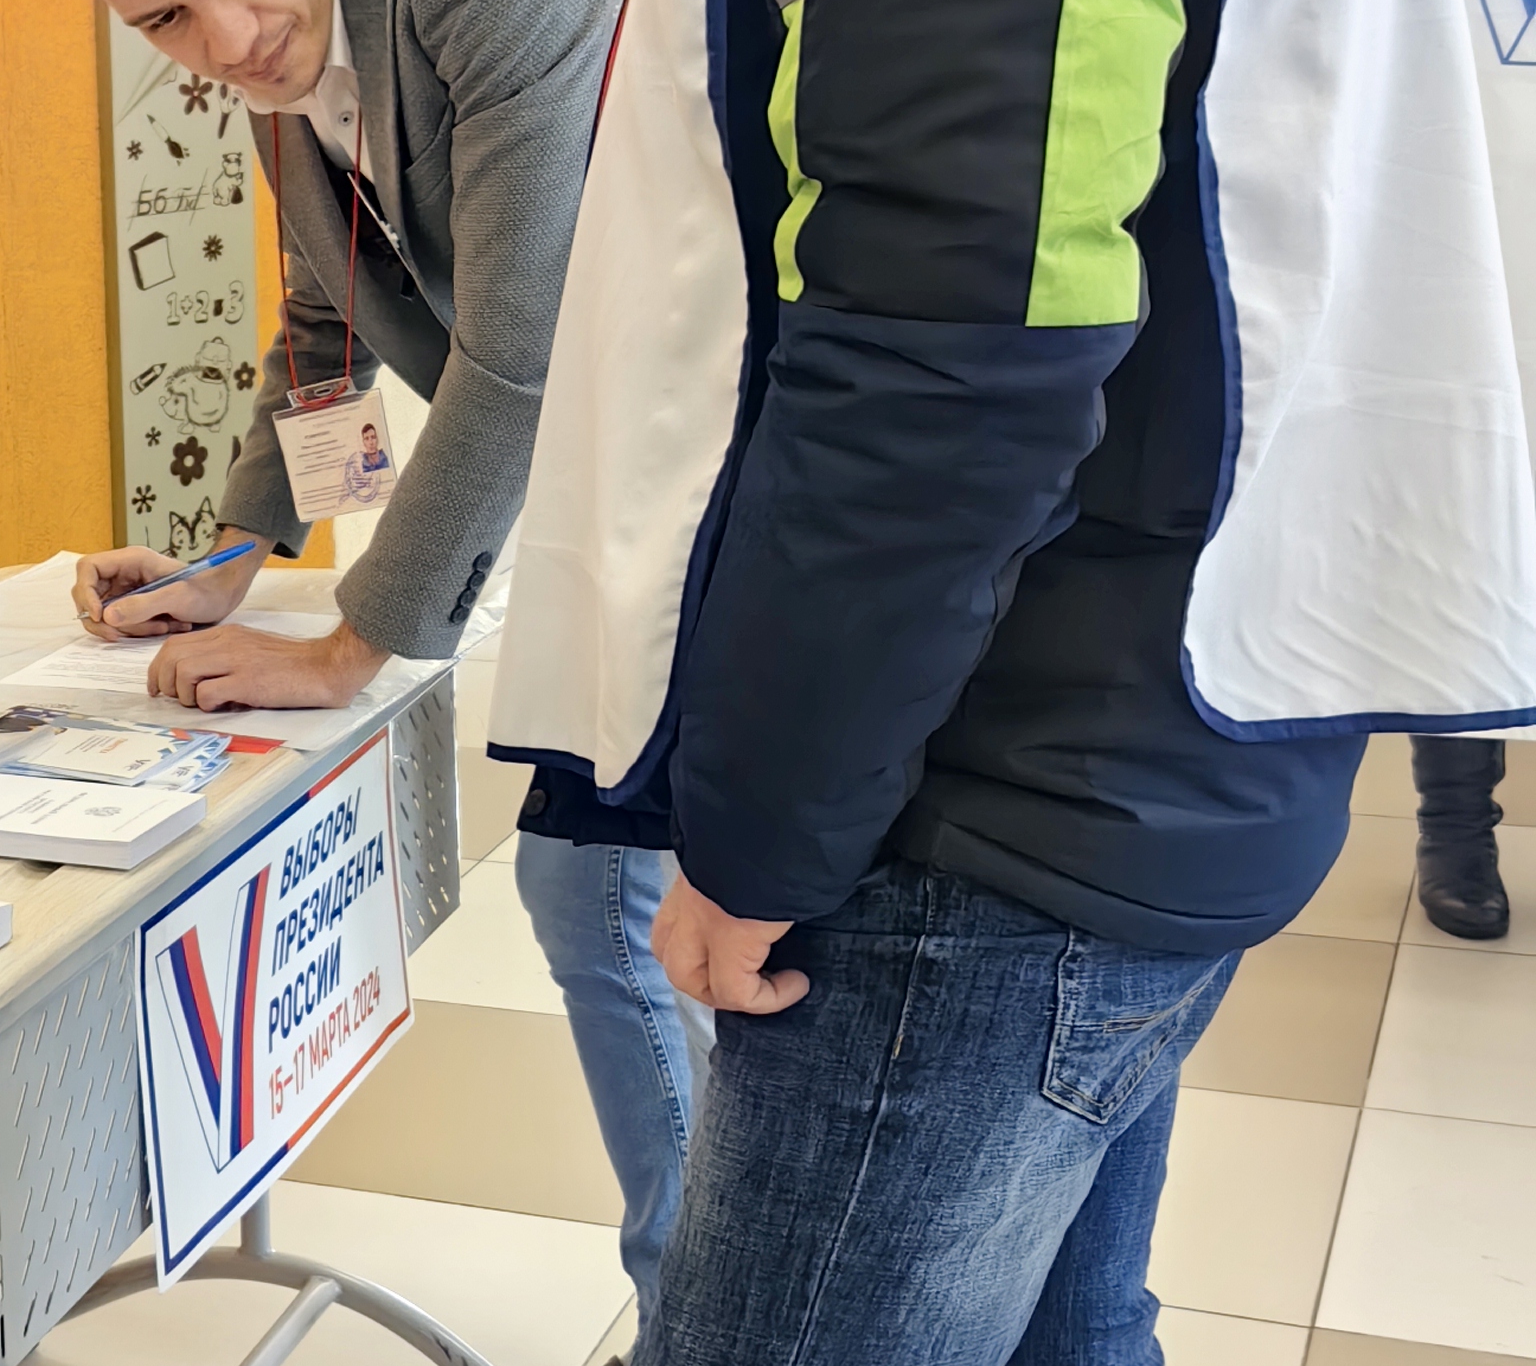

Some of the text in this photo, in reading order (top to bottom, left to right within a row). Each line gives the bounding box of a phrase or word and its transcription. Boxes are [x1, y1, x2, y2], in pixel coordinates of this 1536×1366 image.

[279, 787, 362, 900] ВЫБОРЫ
[271, 830, 386, 977] ПРЕЗИДЕНТА
[267, 935, 343, 1054] РОССИИ
[308, 1004, 351, 1073] МАРТА
[352, 966, 381, 1031] 2024
